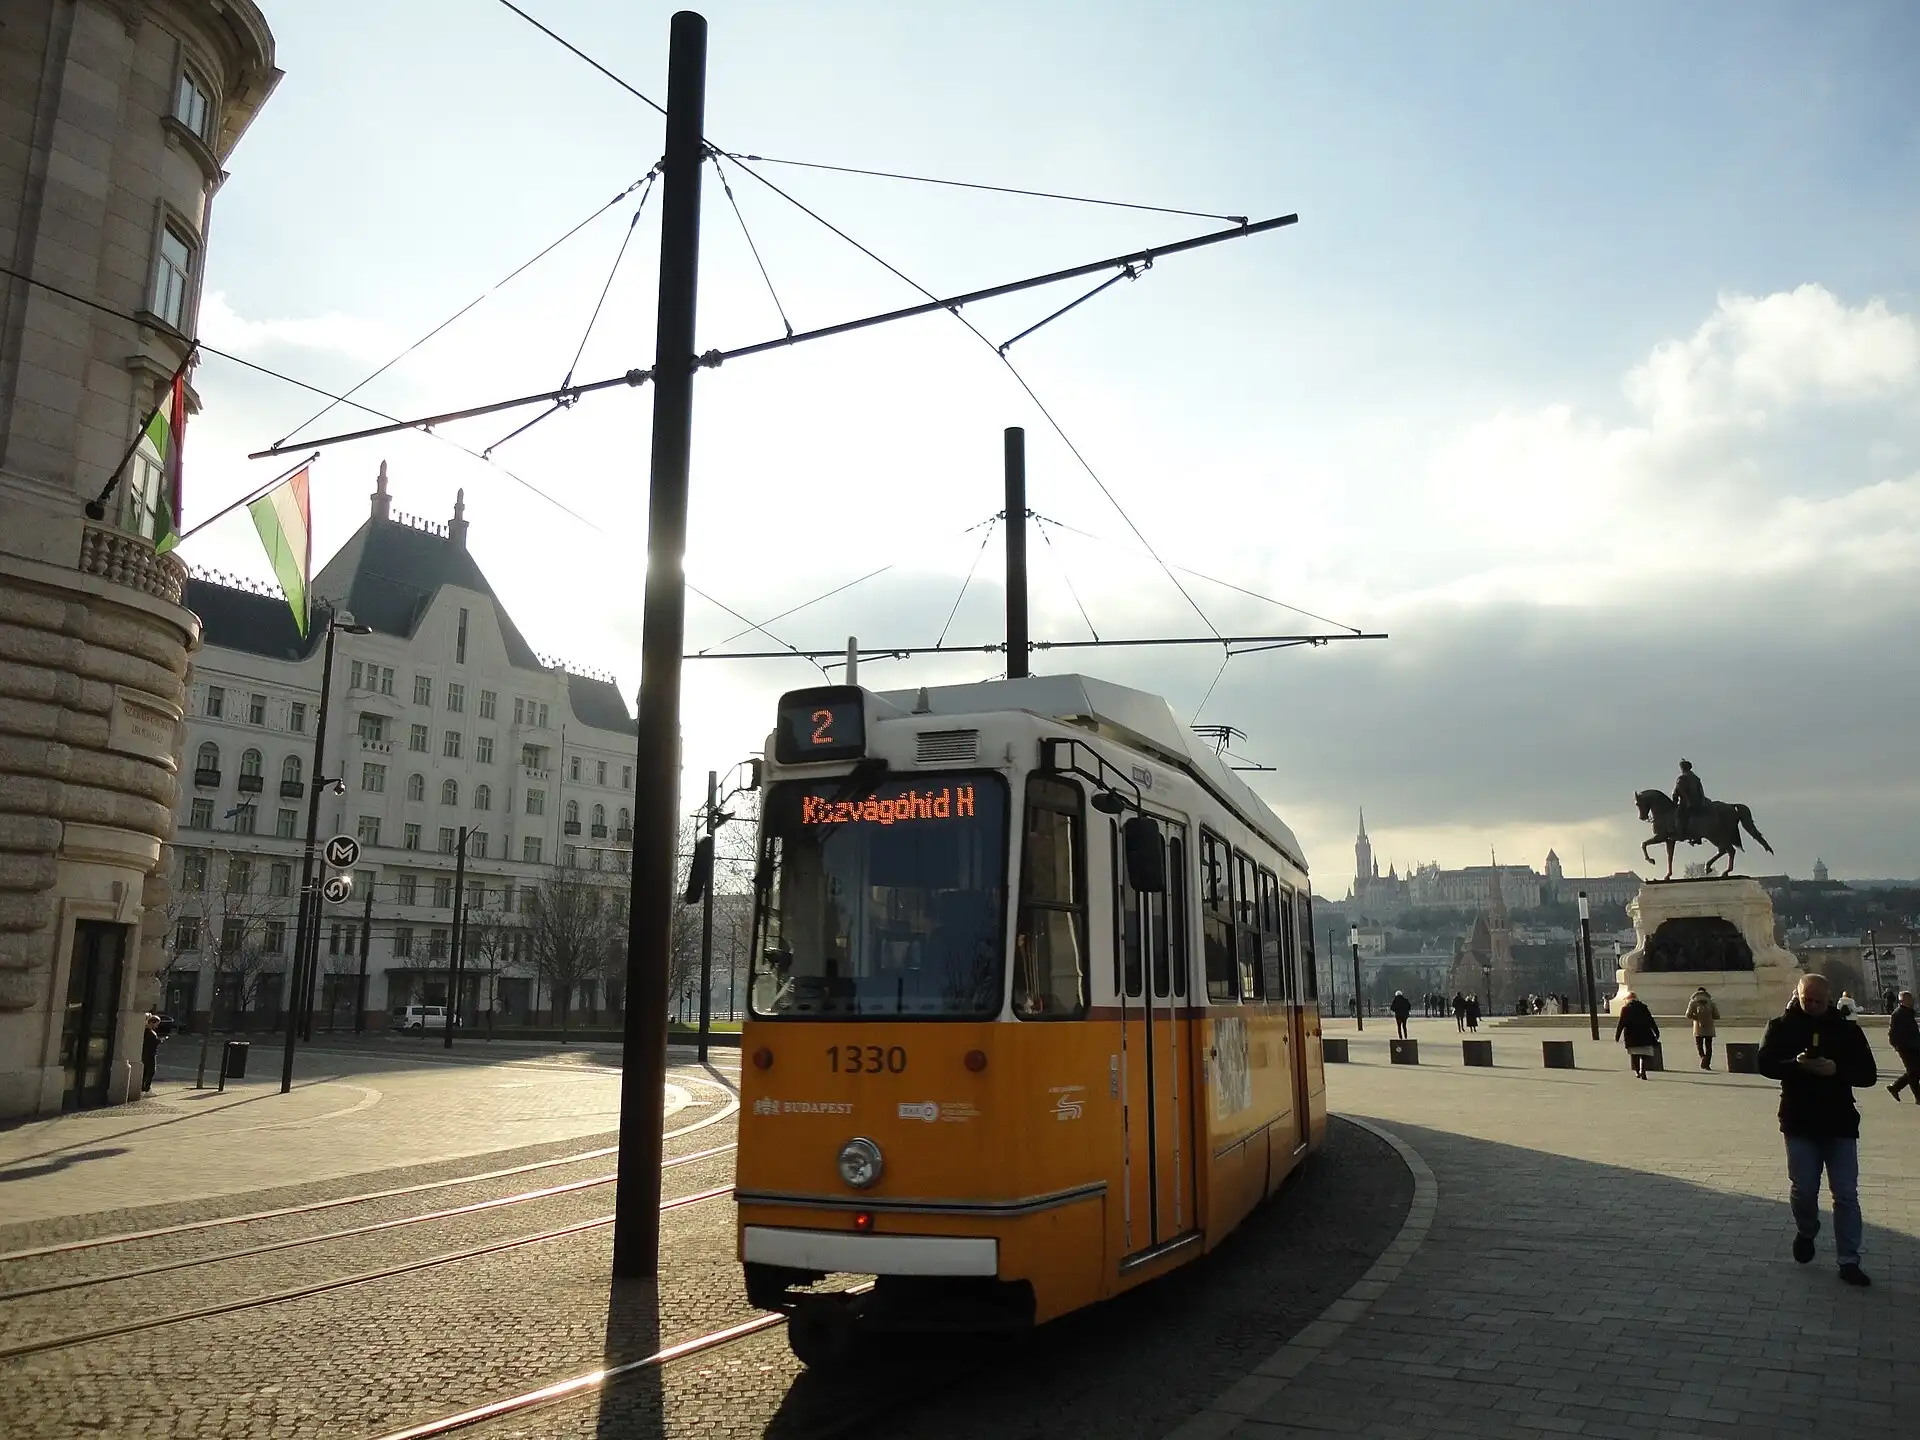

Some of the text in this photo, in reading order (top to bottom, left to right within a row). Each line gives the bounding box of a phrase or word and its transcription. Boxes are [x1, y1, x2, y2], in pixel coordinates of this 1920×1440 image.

[811, 709, 833, 744] 2
[956, 786, 974, 817] H
[331, 841, 354, 862] M
[826, 1045, 907, 1074] 1330
[783, 1101, 854, 1114] BUDAPEST
